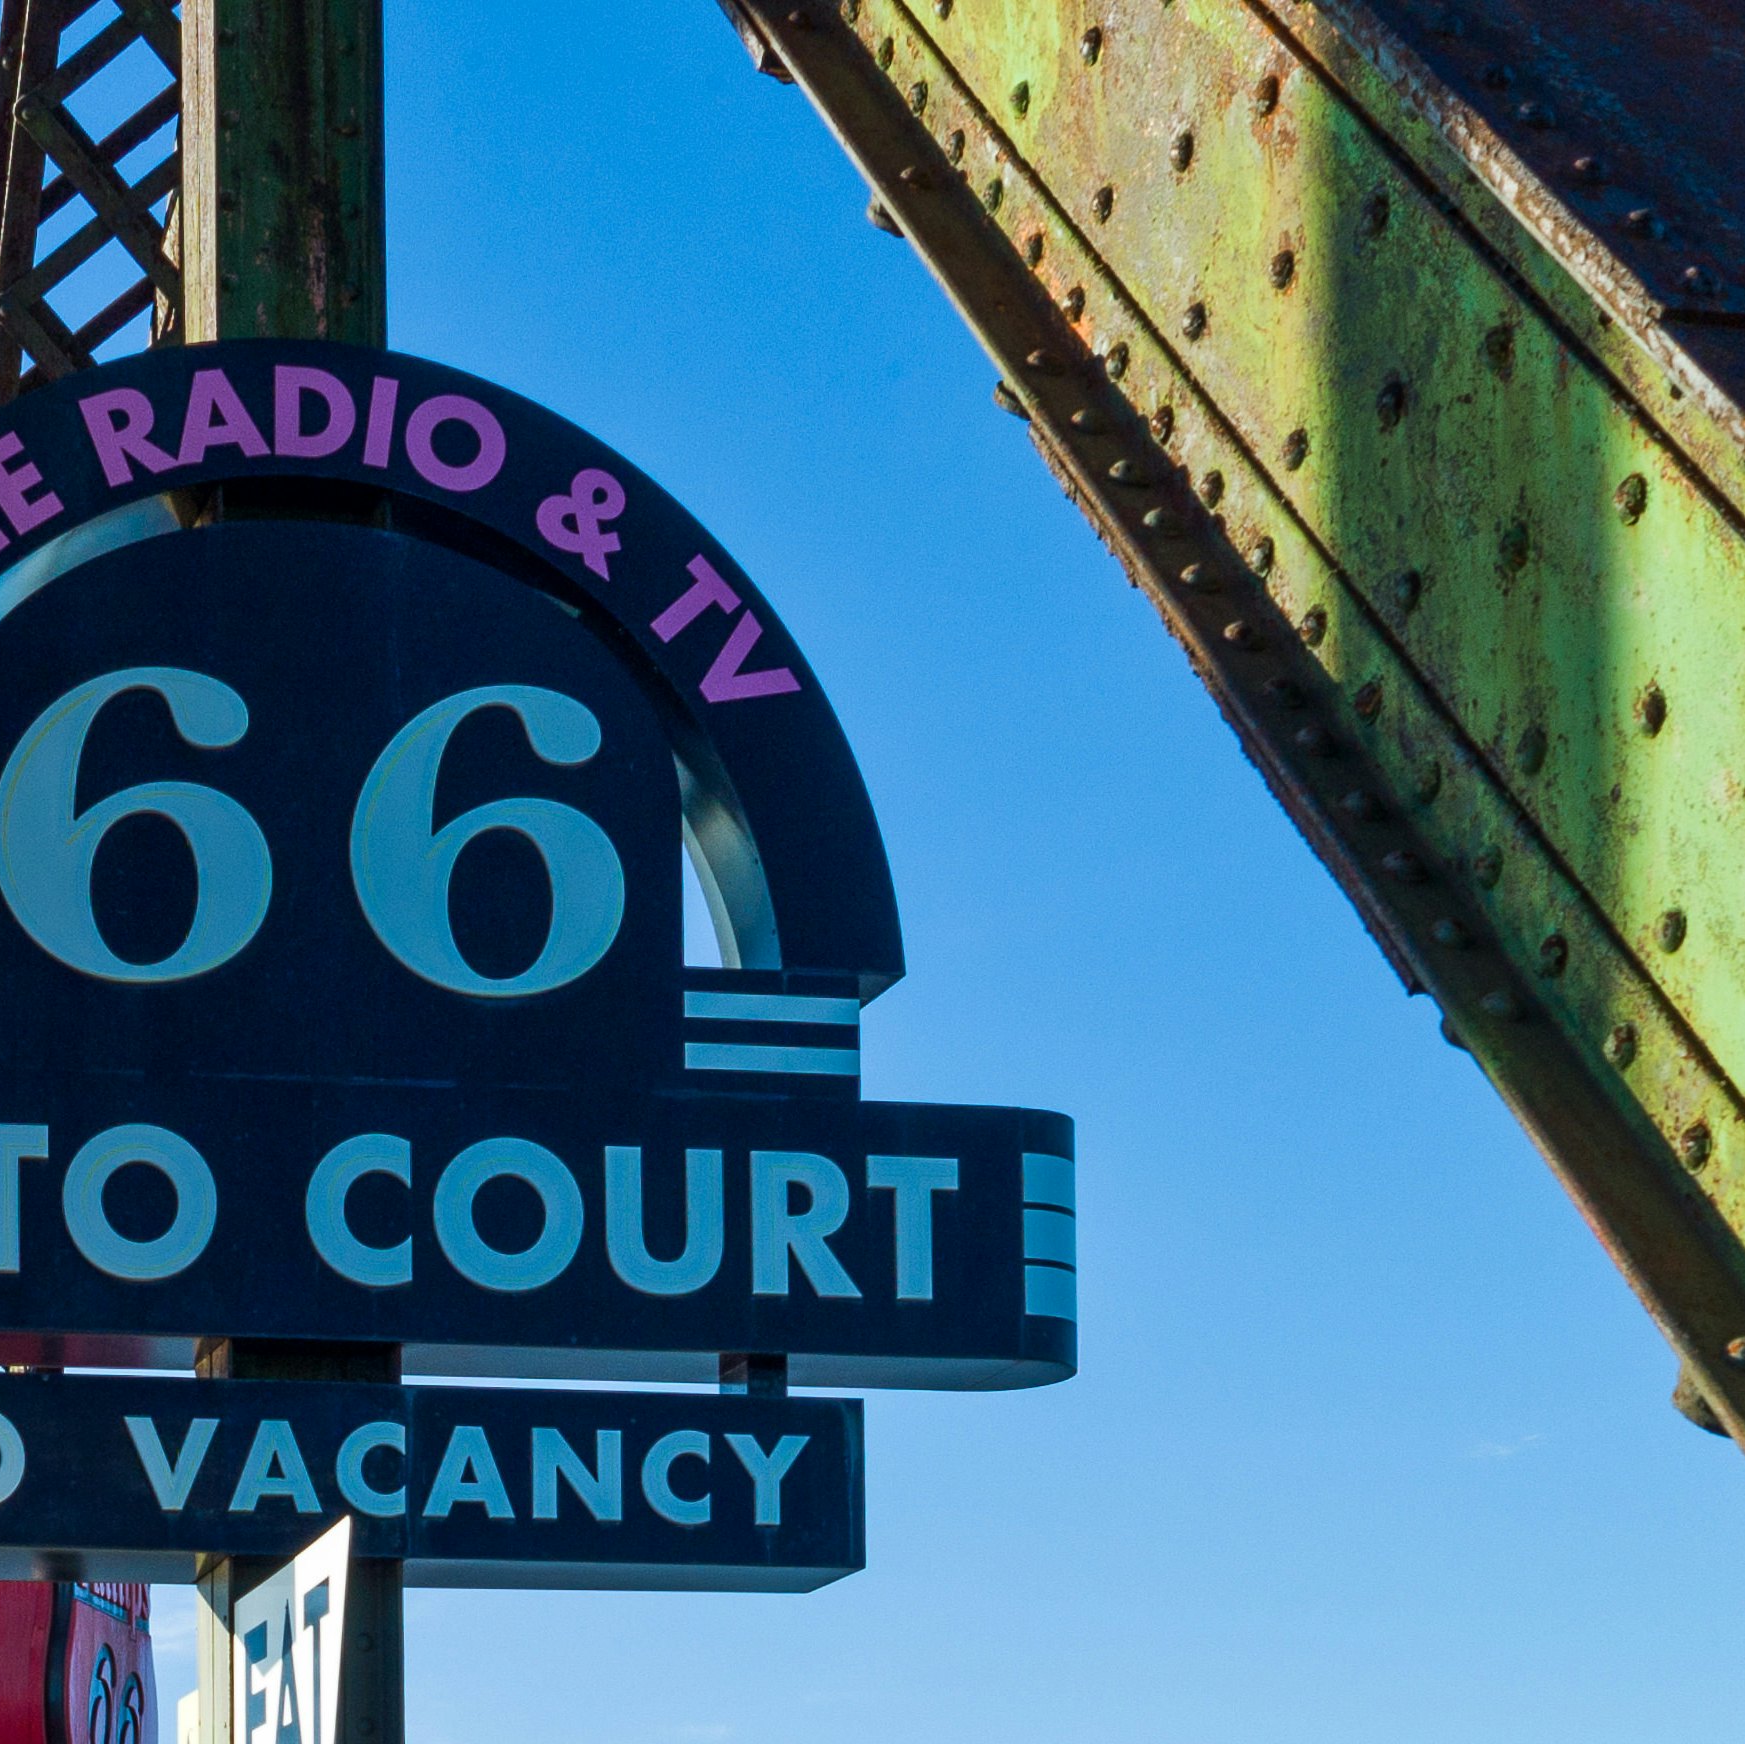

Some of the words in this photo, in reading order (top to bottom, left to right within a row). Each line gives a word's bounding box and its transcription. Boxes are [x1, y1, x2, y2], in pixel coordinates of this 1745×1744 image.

[78, 365, 506, 492] RADIO
[535, 468, 626, 576] &
[650, 554, 800, 704] TV
[306, 1133, 959, 1300] COURT
[124, 1416, 810, 1525] VACANCY
